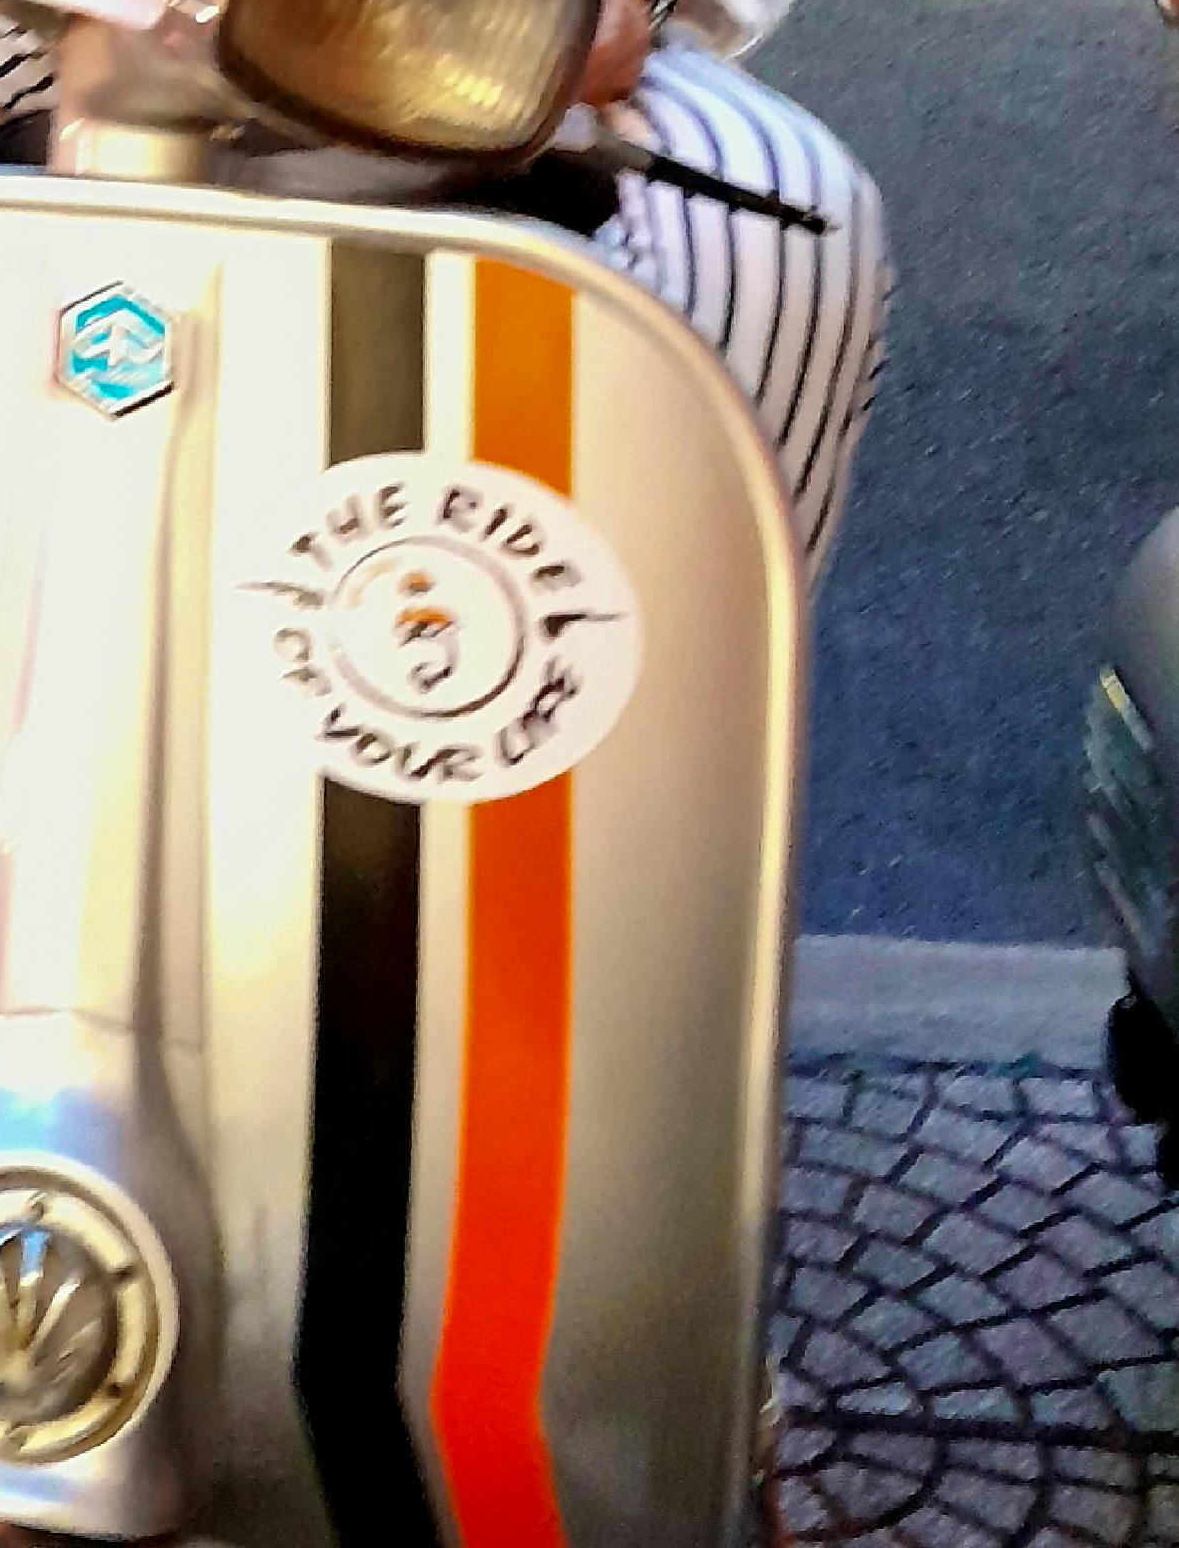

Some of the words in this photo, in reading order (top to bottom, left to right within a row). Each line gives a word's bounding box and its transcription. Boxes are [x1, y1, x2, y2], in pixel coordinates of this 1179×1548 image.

[288, 481, 409, 571] THE
[435, 483, 585, 591] RIDE
[316, 702, 485, 782] YOUR
